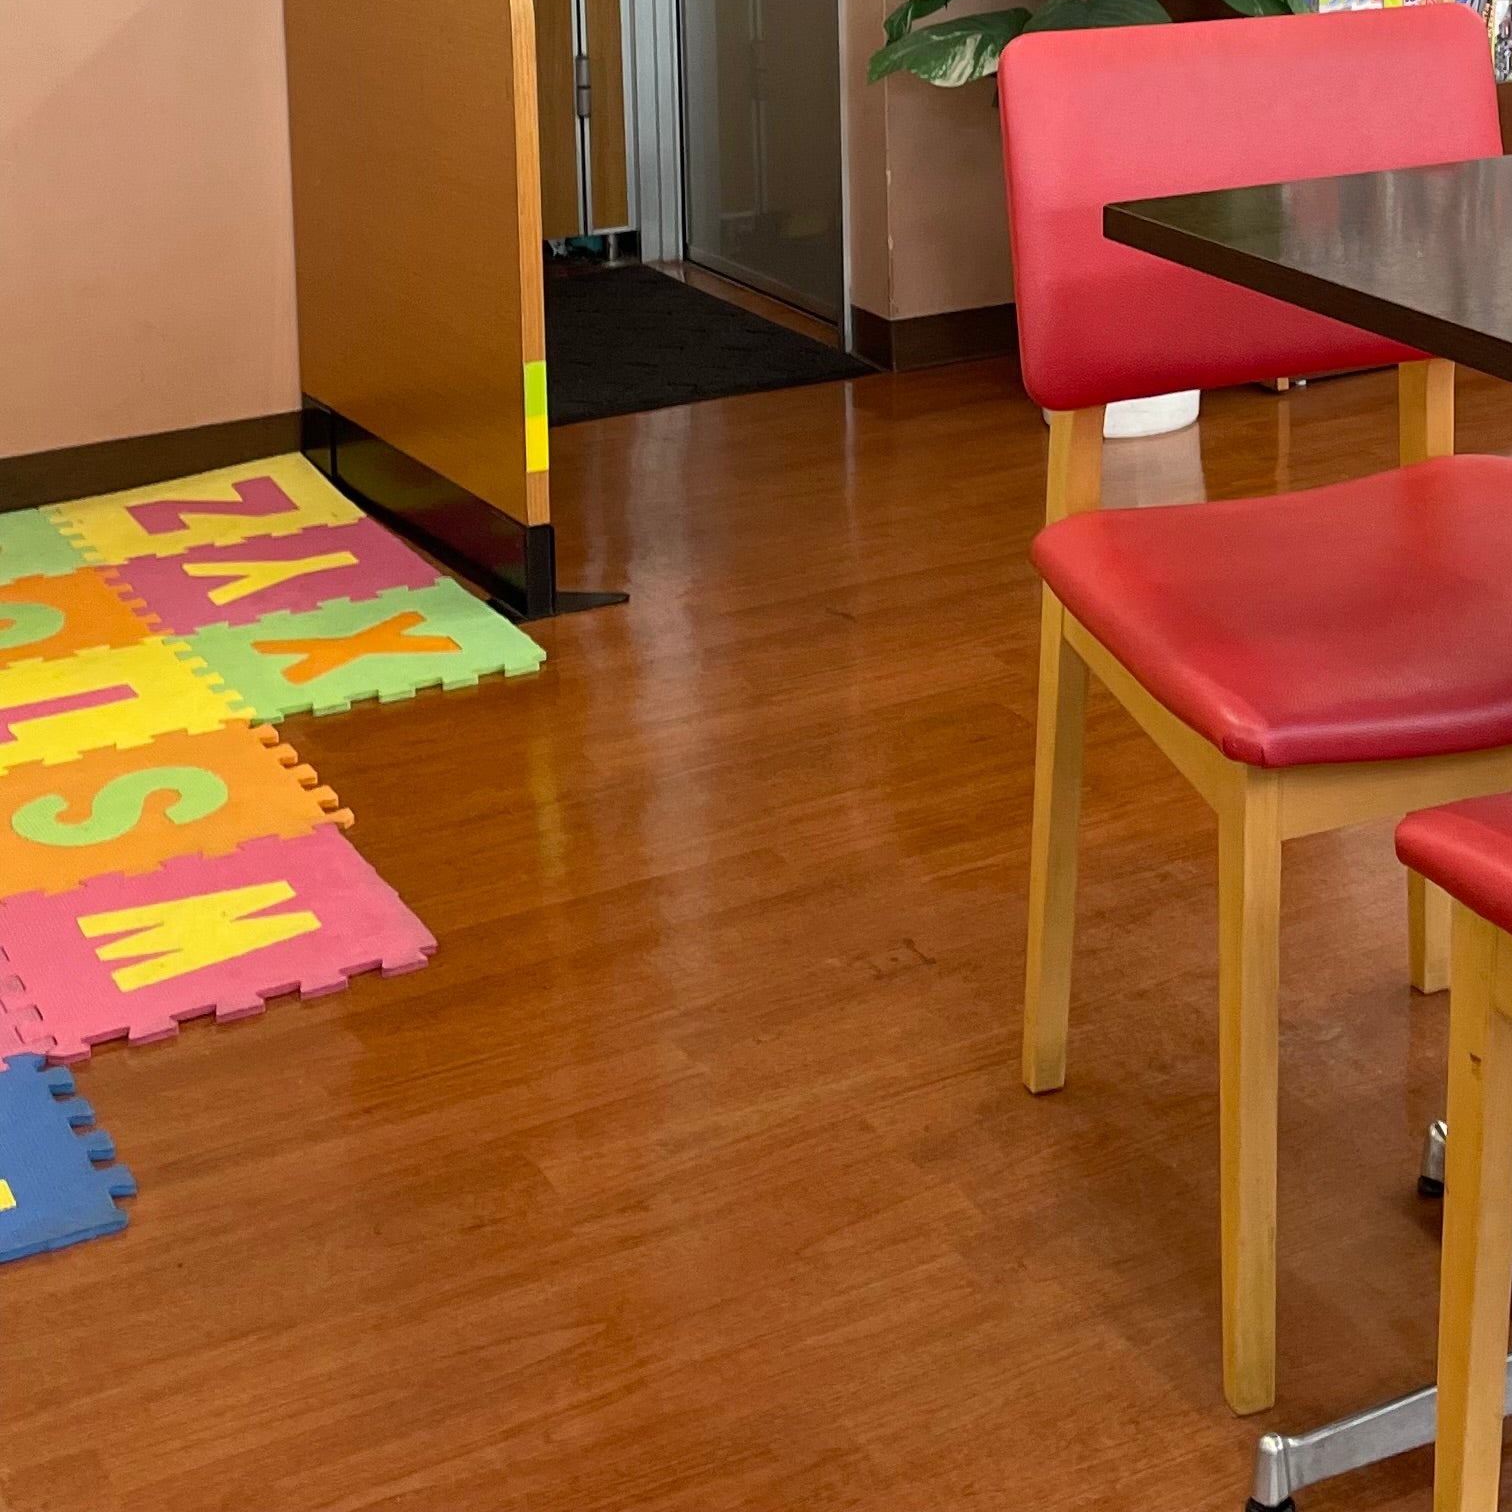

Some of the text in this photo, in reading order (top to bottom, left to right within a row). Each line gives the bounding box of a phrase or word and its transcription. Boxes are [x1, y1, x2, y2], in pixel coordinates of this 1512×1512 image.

[182, 551, 360, 606] Y
[251, 611, 462, 685] X
[11, 765, 229, 847] S
